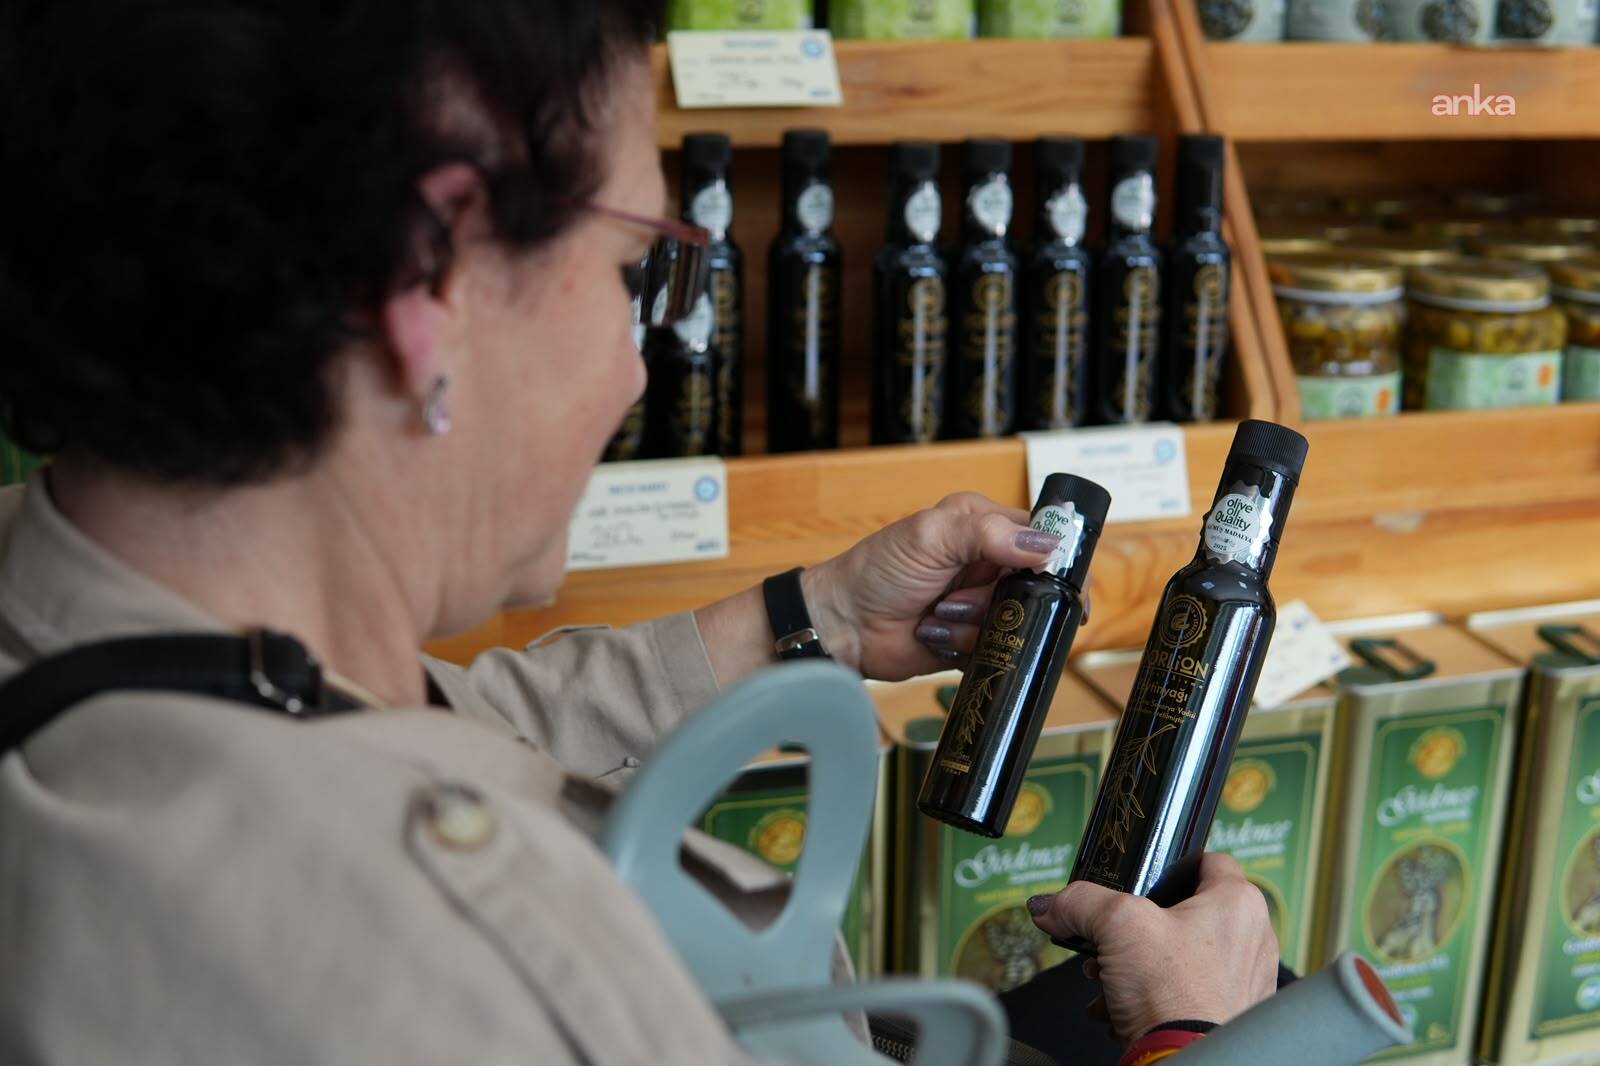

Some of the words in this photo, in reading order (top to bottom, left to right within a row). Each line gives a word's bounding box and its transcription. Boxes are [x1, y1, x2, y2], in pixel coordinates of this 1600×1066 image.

[1227, 498, 1253, 513] olive
[1045, 510, 1069, 525] olive
[1215, 510, 1251, 531] Quality
